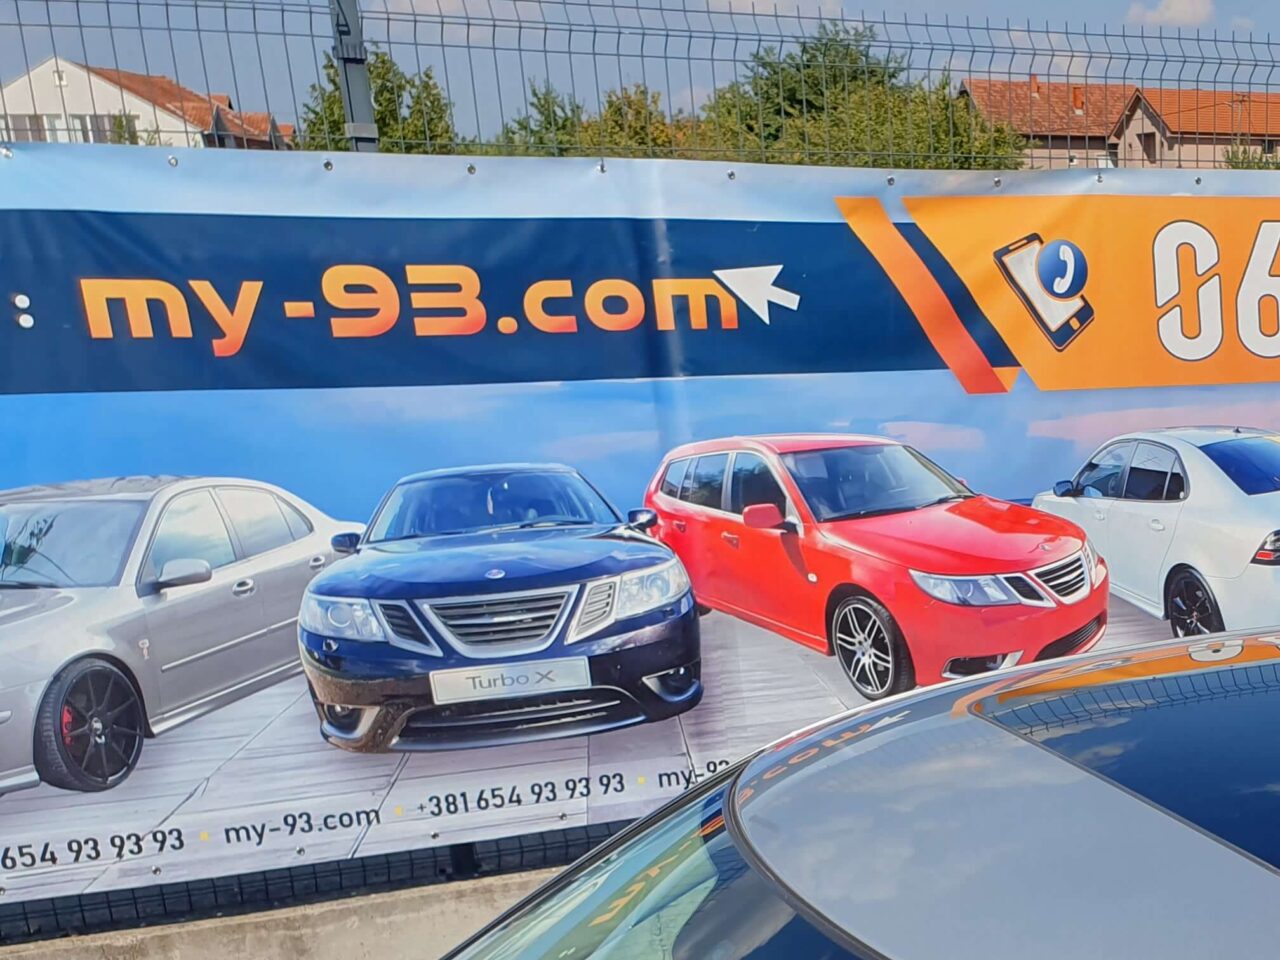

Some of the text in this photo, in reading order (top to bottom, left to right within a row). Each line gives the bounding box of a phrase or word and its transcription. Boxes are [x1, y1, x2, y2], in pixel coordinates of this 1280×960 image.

[80, 264, 739, 357] my-93.com
[465, 670, 556, 690] Turbo X
[1, 842, 58, 870] 654
[67, 838, 101, 863] 93
[110, 833, 143, 859] 93
[152, 828, 185, 853] 93
[225, 808, 381, 846] my-93.com
[417, 791, 470, 817] +381
[476, 785, 522, 810] 654
[530, 782, 557, 804] 93
[565, 777, 592, 800] 93
[599, 773, 625, 796] 93
